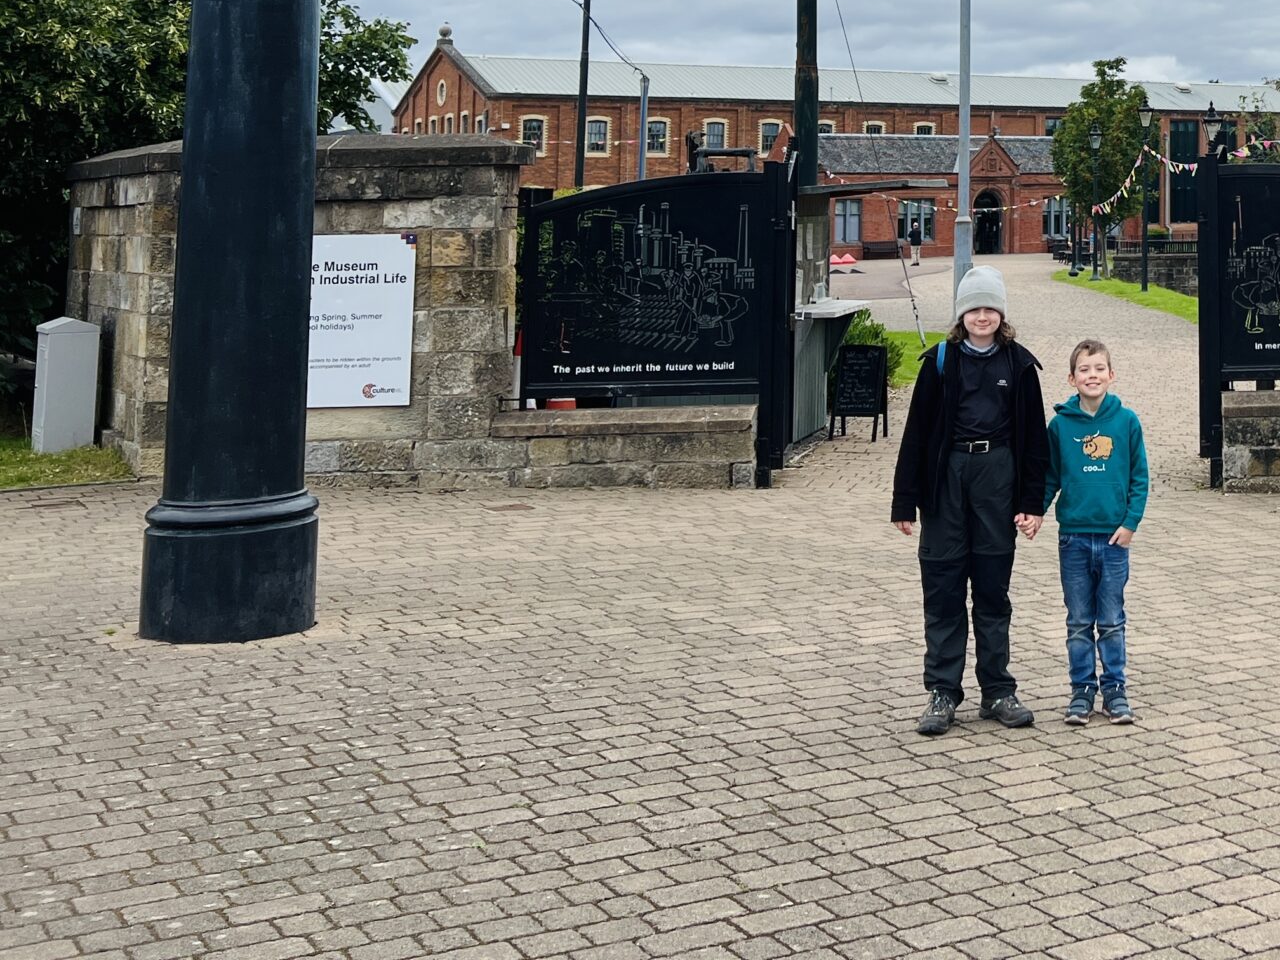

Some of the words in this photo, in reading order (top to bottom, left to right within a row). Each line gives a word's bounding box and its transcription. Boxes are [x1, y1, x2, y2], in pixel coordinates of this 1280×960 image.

[324, 261, 378, 272] Museum
[320, 273, 379, 285] Industrial
[384, 272, 407, 284] Life
[320, 323, 354, 331] holidays)
[1254, 342, 1263, 350] In
[553, 365, 570, 374] The
[575, 365, 595, 375] past
[613, 364, 642, 372] inherit
[646, 364, 661, 372] the
[665, 363, 693, 371] future
[712, 362, 735, 370] build
